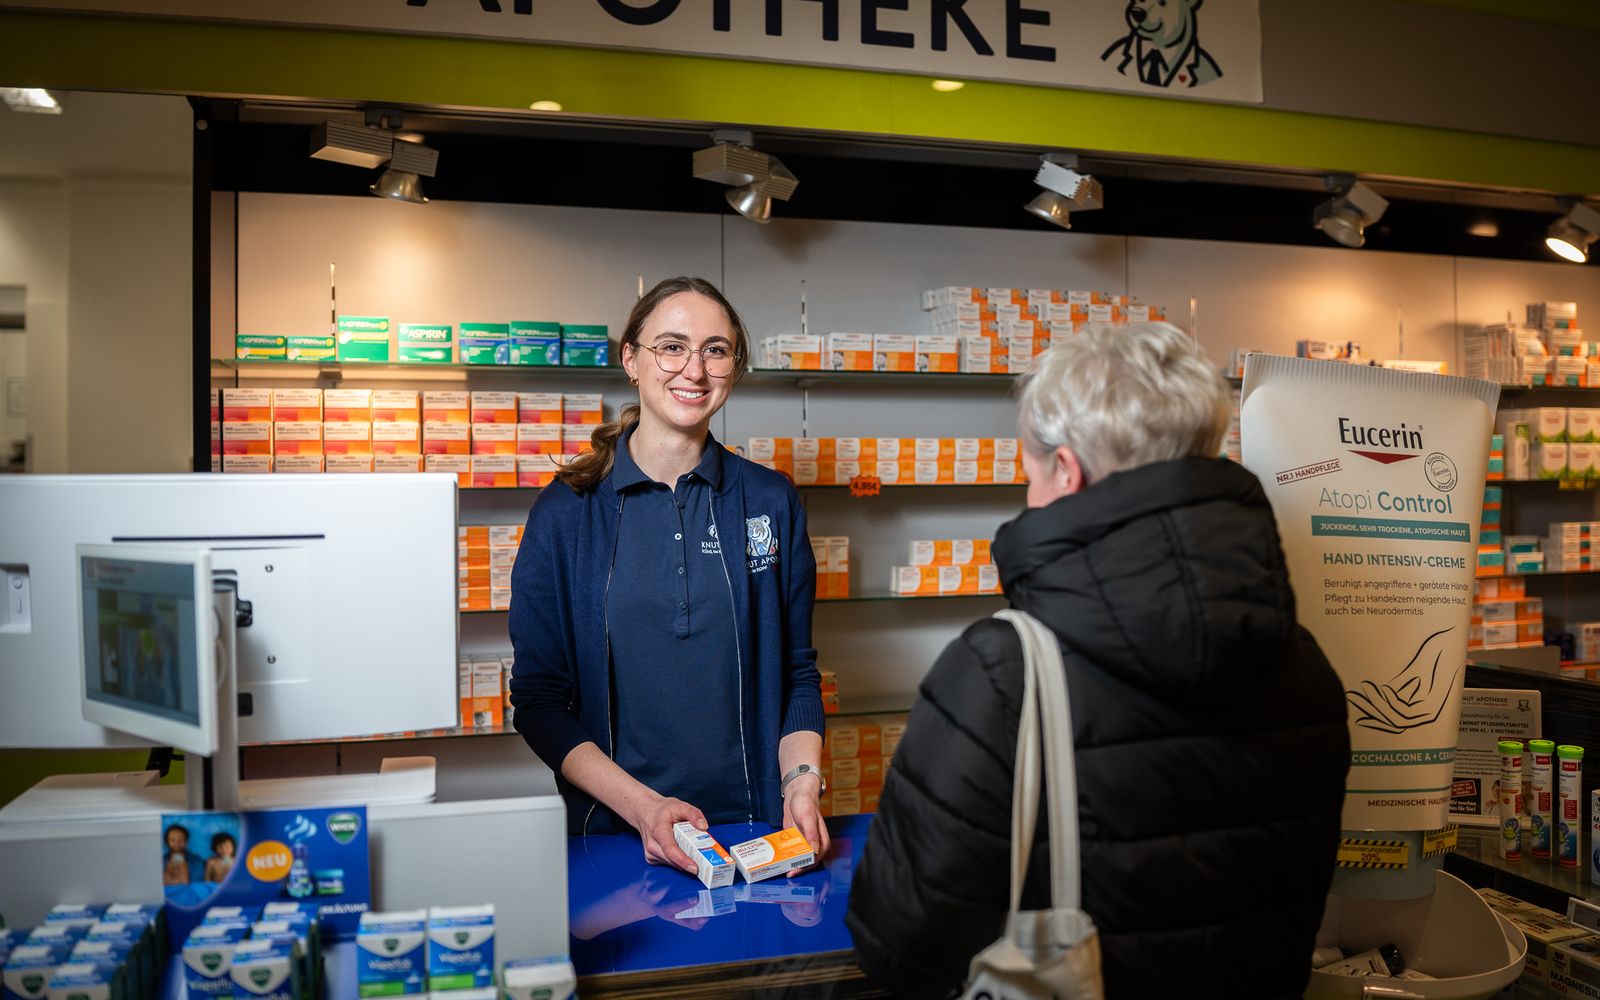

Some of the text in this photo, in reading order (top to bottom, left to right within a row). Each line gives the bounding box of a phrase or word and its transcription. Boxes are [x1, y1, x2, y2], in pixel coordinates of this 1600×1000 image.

[408, 329, 447, 340] ASPIRIN
[1295, 461, 1341, 478] HANDPFLEGE
[1318, 487, 1453, 514] Atopi Control
[1320, 523, 1359, 532] JUCKENDE,
[1378, 526, 1414, 535] TROCKENE,
[1414, 528, 1450, 536] ATOPISCHE
[1323, 552, 1466, 569] HAND INTENSIV-CREME
[1324, 579, 1362, 589] Beruhigt
[1363, 580, 1412, 589] angegriffene
[1419, 581, 1450, 590] gerötete
[1324, 594, 1353, 605] Pflegt
[1366, 594, 1414, 603] Handekzem
[1416, 596, 1451, 605] neigende
[1324, 607, 1424, 616] auch bei Neurodermitis
[1352, 752, 1423, 763] COCHALCONE
[1424, 752, 1432, 761] A
[1367, 799, 1427, 807] MEDIZINISCHE
[251, 854, 288, 870] NEU
[1551, 982, 1568, 994] 400
